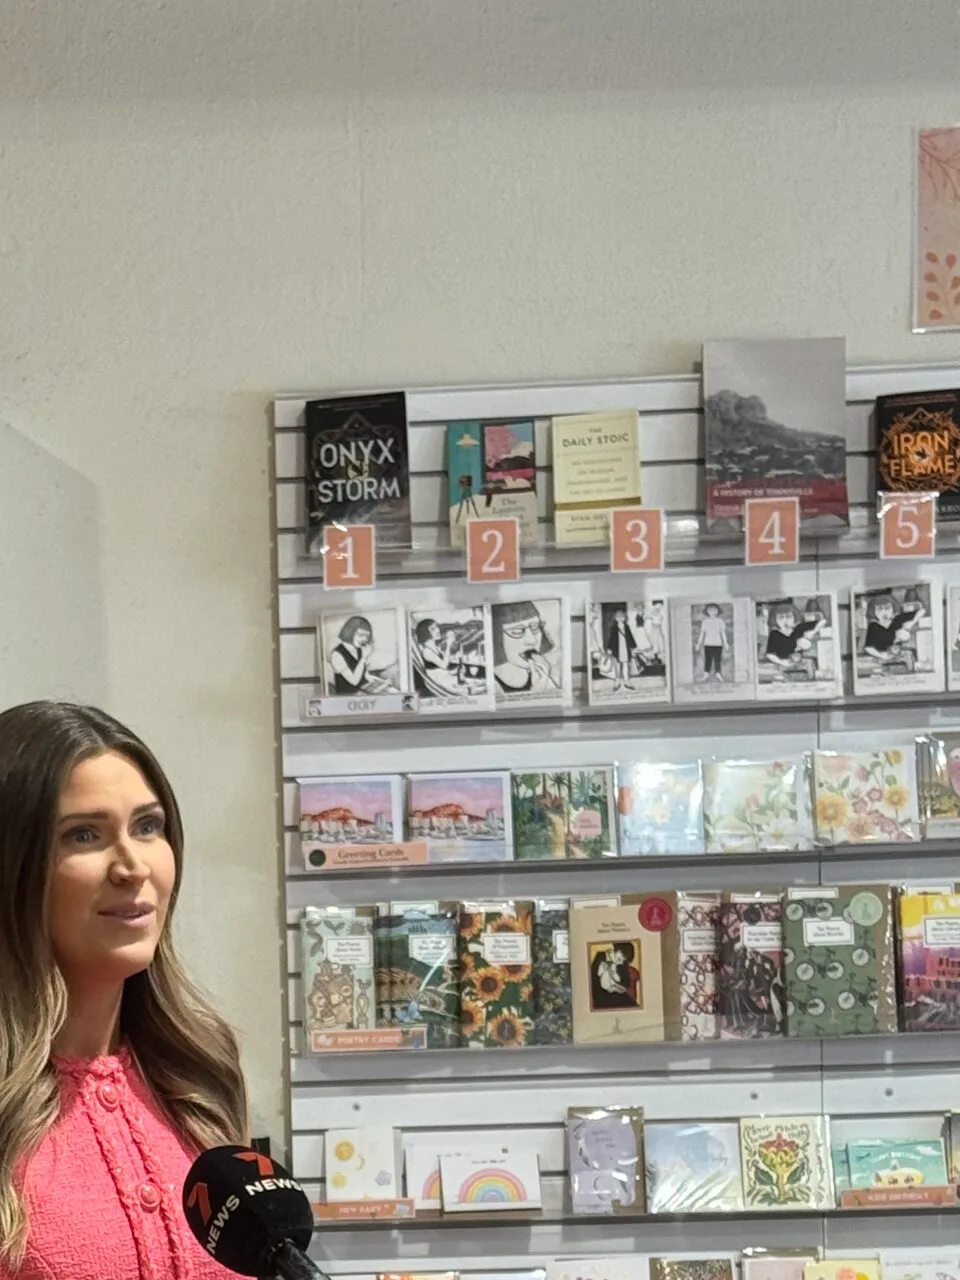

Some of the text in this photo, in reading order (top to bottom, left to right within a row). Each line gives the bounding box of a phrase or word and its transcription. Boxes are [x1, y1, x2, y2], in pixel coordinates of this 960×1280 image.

[319, 438, 395, 468] ONYX
[562, 433, 630, 448] DAILY STOIC
[893, 431, 949, 456] IRON
[890, 455, 955, 477] FLAME
[318, 478, 400, 504] STORM
[625, 519, 649, 562] 3
[759, 511, 786, 554] 4
[895, 505, 920, 548] 5
[339, 535, 359, 579] 1
[481, 530, 505, 573] 2
[206, 1195, 240, 1255] NEWS
